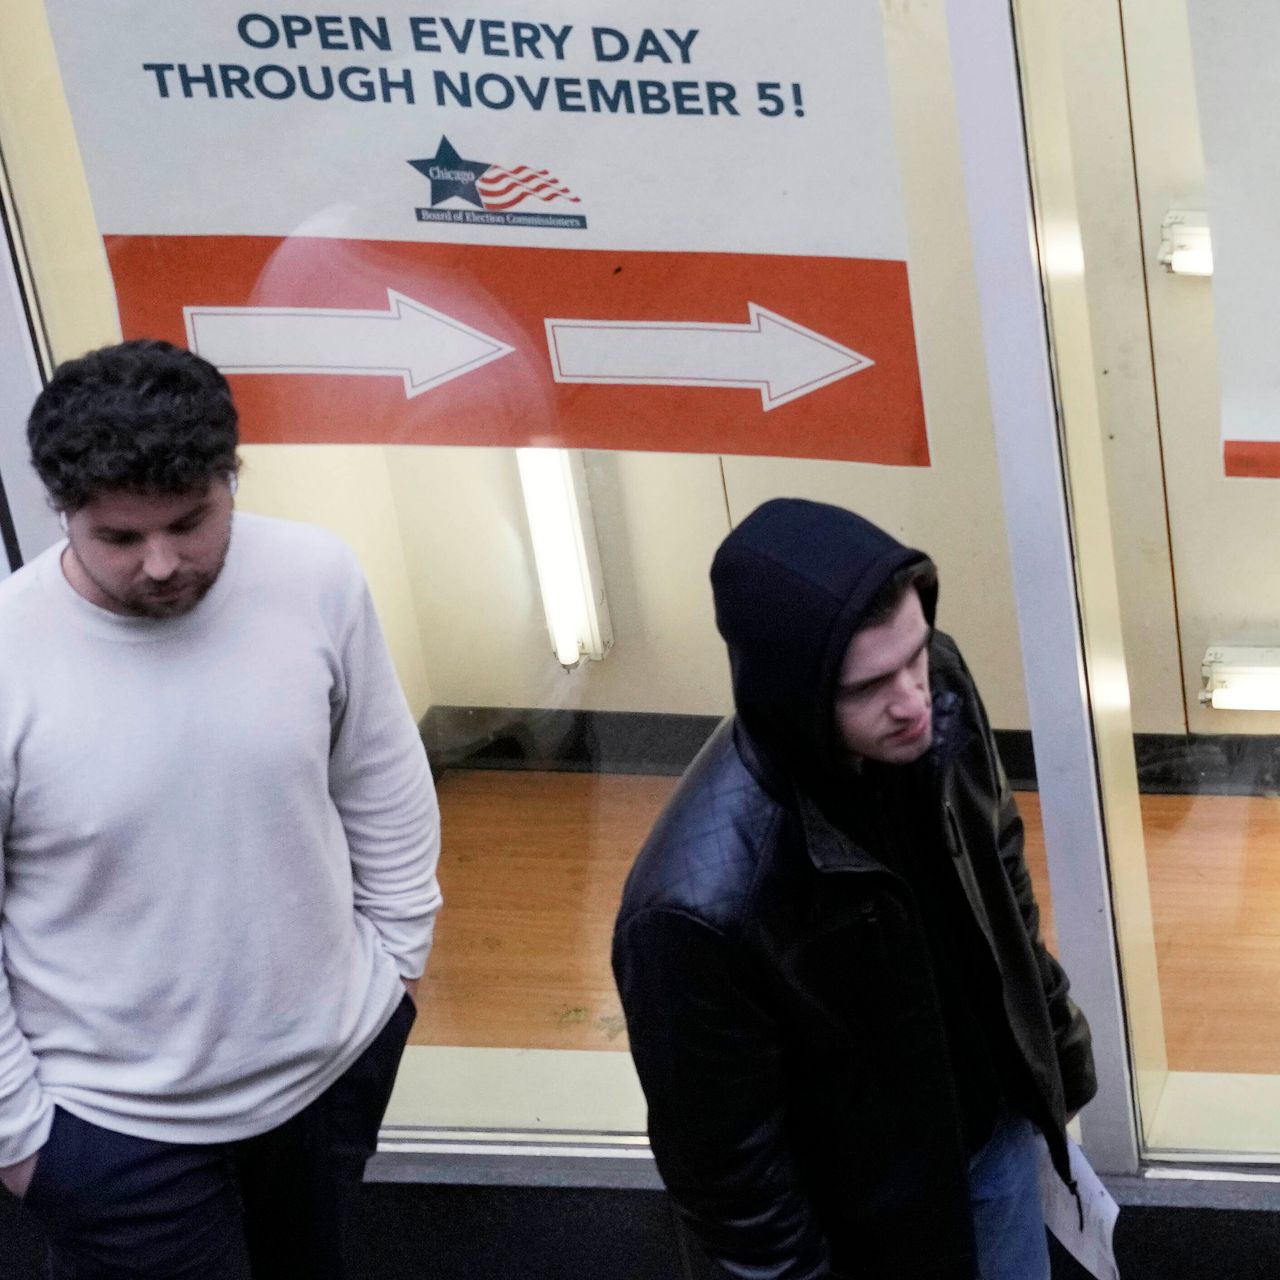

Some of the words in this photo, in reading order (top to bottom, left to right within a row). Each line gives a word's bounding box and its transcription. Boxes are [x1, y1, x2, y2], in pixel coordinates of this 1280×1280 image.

[238, 14, 391, 51] OPEN
[409, 17, 573, 60] EVERY
[592, 27, 699, 64] DAY
[143, 63, 415, 104] THROUGH
[434, 71, 740, 115] NOVEMBER
[757, 82, 804, 117] 5!
[429, 167, 476, 184] Chicago
[422, 209, 451, 221] Board
[453, 211, 464, 222] of
[466, 211, 504, 223] Election
[506, 214, 581, 227] Commissioners
